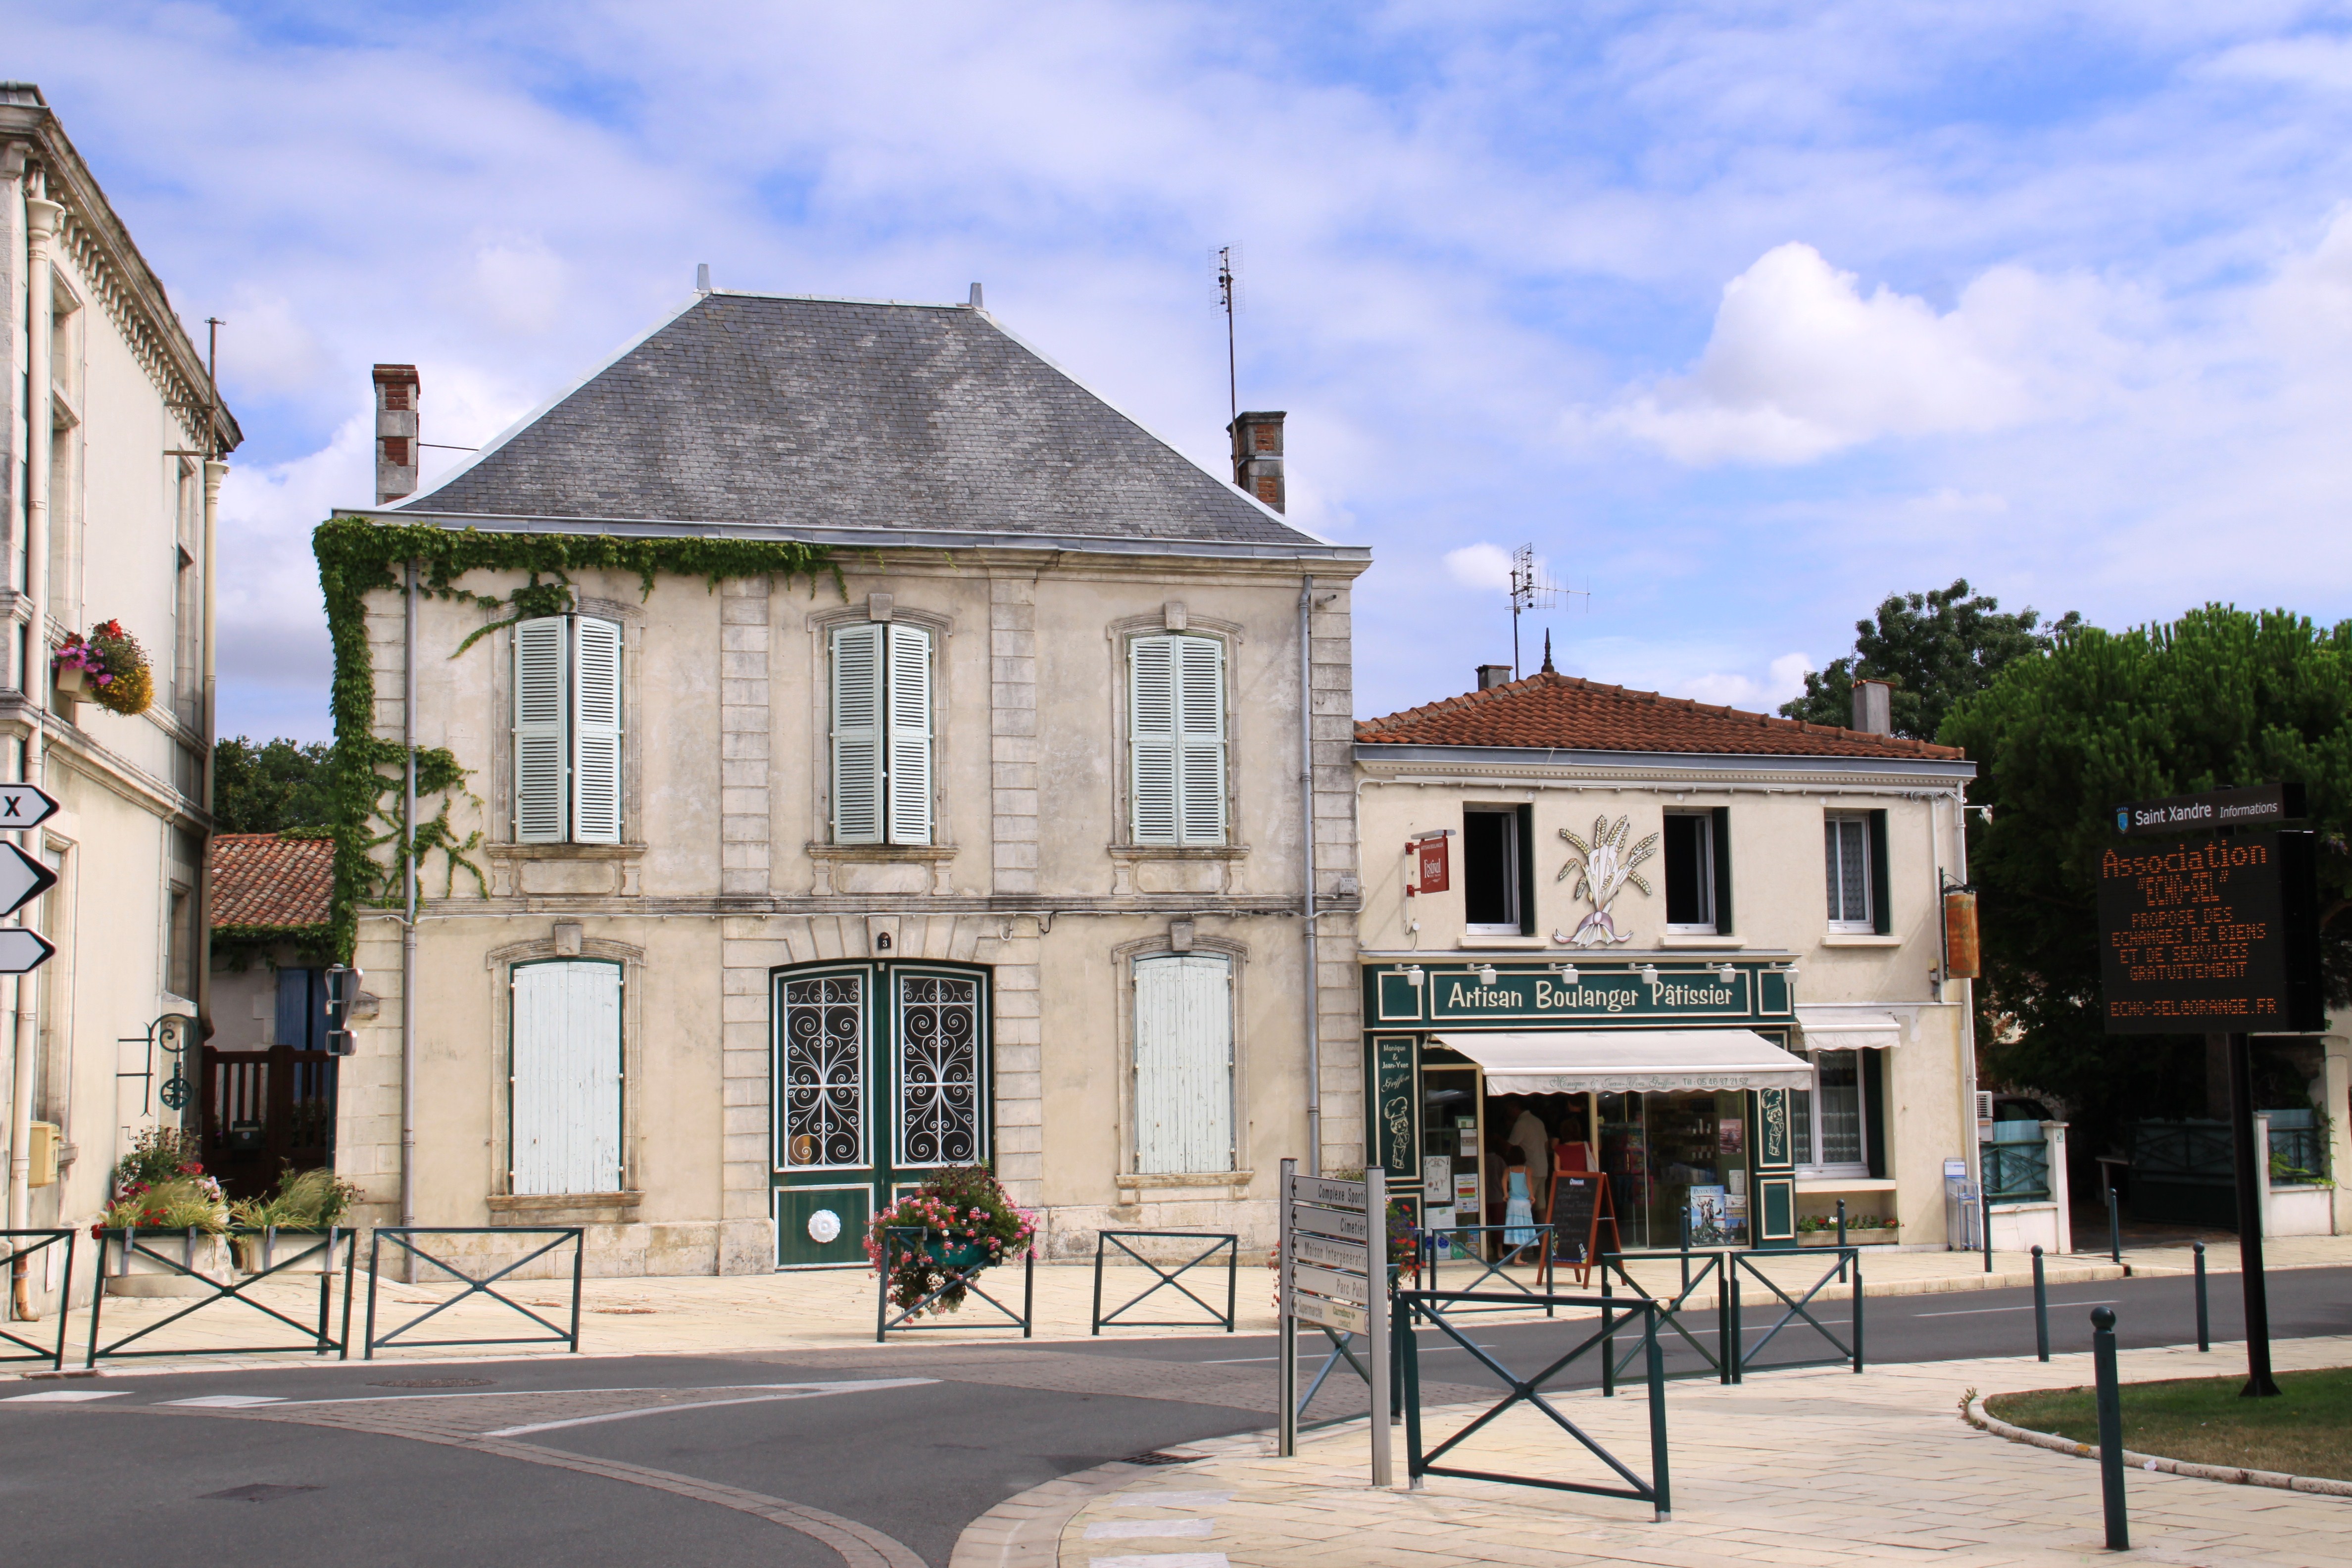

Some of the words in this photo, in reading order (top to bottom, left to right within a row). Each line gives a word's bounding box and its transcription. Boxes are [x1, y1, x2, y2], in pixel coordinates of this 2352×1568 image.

[2135, 809, 2166, 826] Saint
[2168, 803, 2211, 822] Xandre
[2220, 802, 2278, 818] Informations
[1424, 858, 1441, 879] Festival
[2103, 839, 2267, 878] Association
[2132, 909, 2196, 928] PROPOSE
[2204, 906, 2233, 924] DES
[2111, 928, 2184, 947] ECHANGES
[2192, 927, 2211, 942] DE
[2218, 923, 2267, 940] BIENS
[2120, 948, 2139, 964] ET
[2146, 947, 2164, 963] DE
[2172, 942, 2249, 961] SERVICES
[2130, 961, 2248, 980] GRATUITEMENT
[1448, 981, 1522, 1008] Artisan
[1535, 980, 1639, 1012] Boulanger
[1652, 981, 1733, 1006] Pâtissier
[2110, 998, 2277, 1016] ECHO-SEL@ORANGE.FR
[1383, 1044, 1406, 1053] Monique
[1381, 1073, 1410, 1092] Griffon
[1549, 1076, 1585, 1090] Monique
[1601, 1076, 1645, 1089] Jean-Yves
[1649, 1076, 1676, 1089] Griffon
[1318, 1183, 1345, 1203] Complexe
[1348, 1187, 1366, 1206] Sporti
[1340, 1217, 1366, 1235] Cimetièr
[1304, 1241, 1323, 1258] Maison
[1325, 1245, 1367, 1268] Intergénératio
[1336, 1278, 1349, 1295] Parc
[1352, 1282, 1367, 1299] Publi
